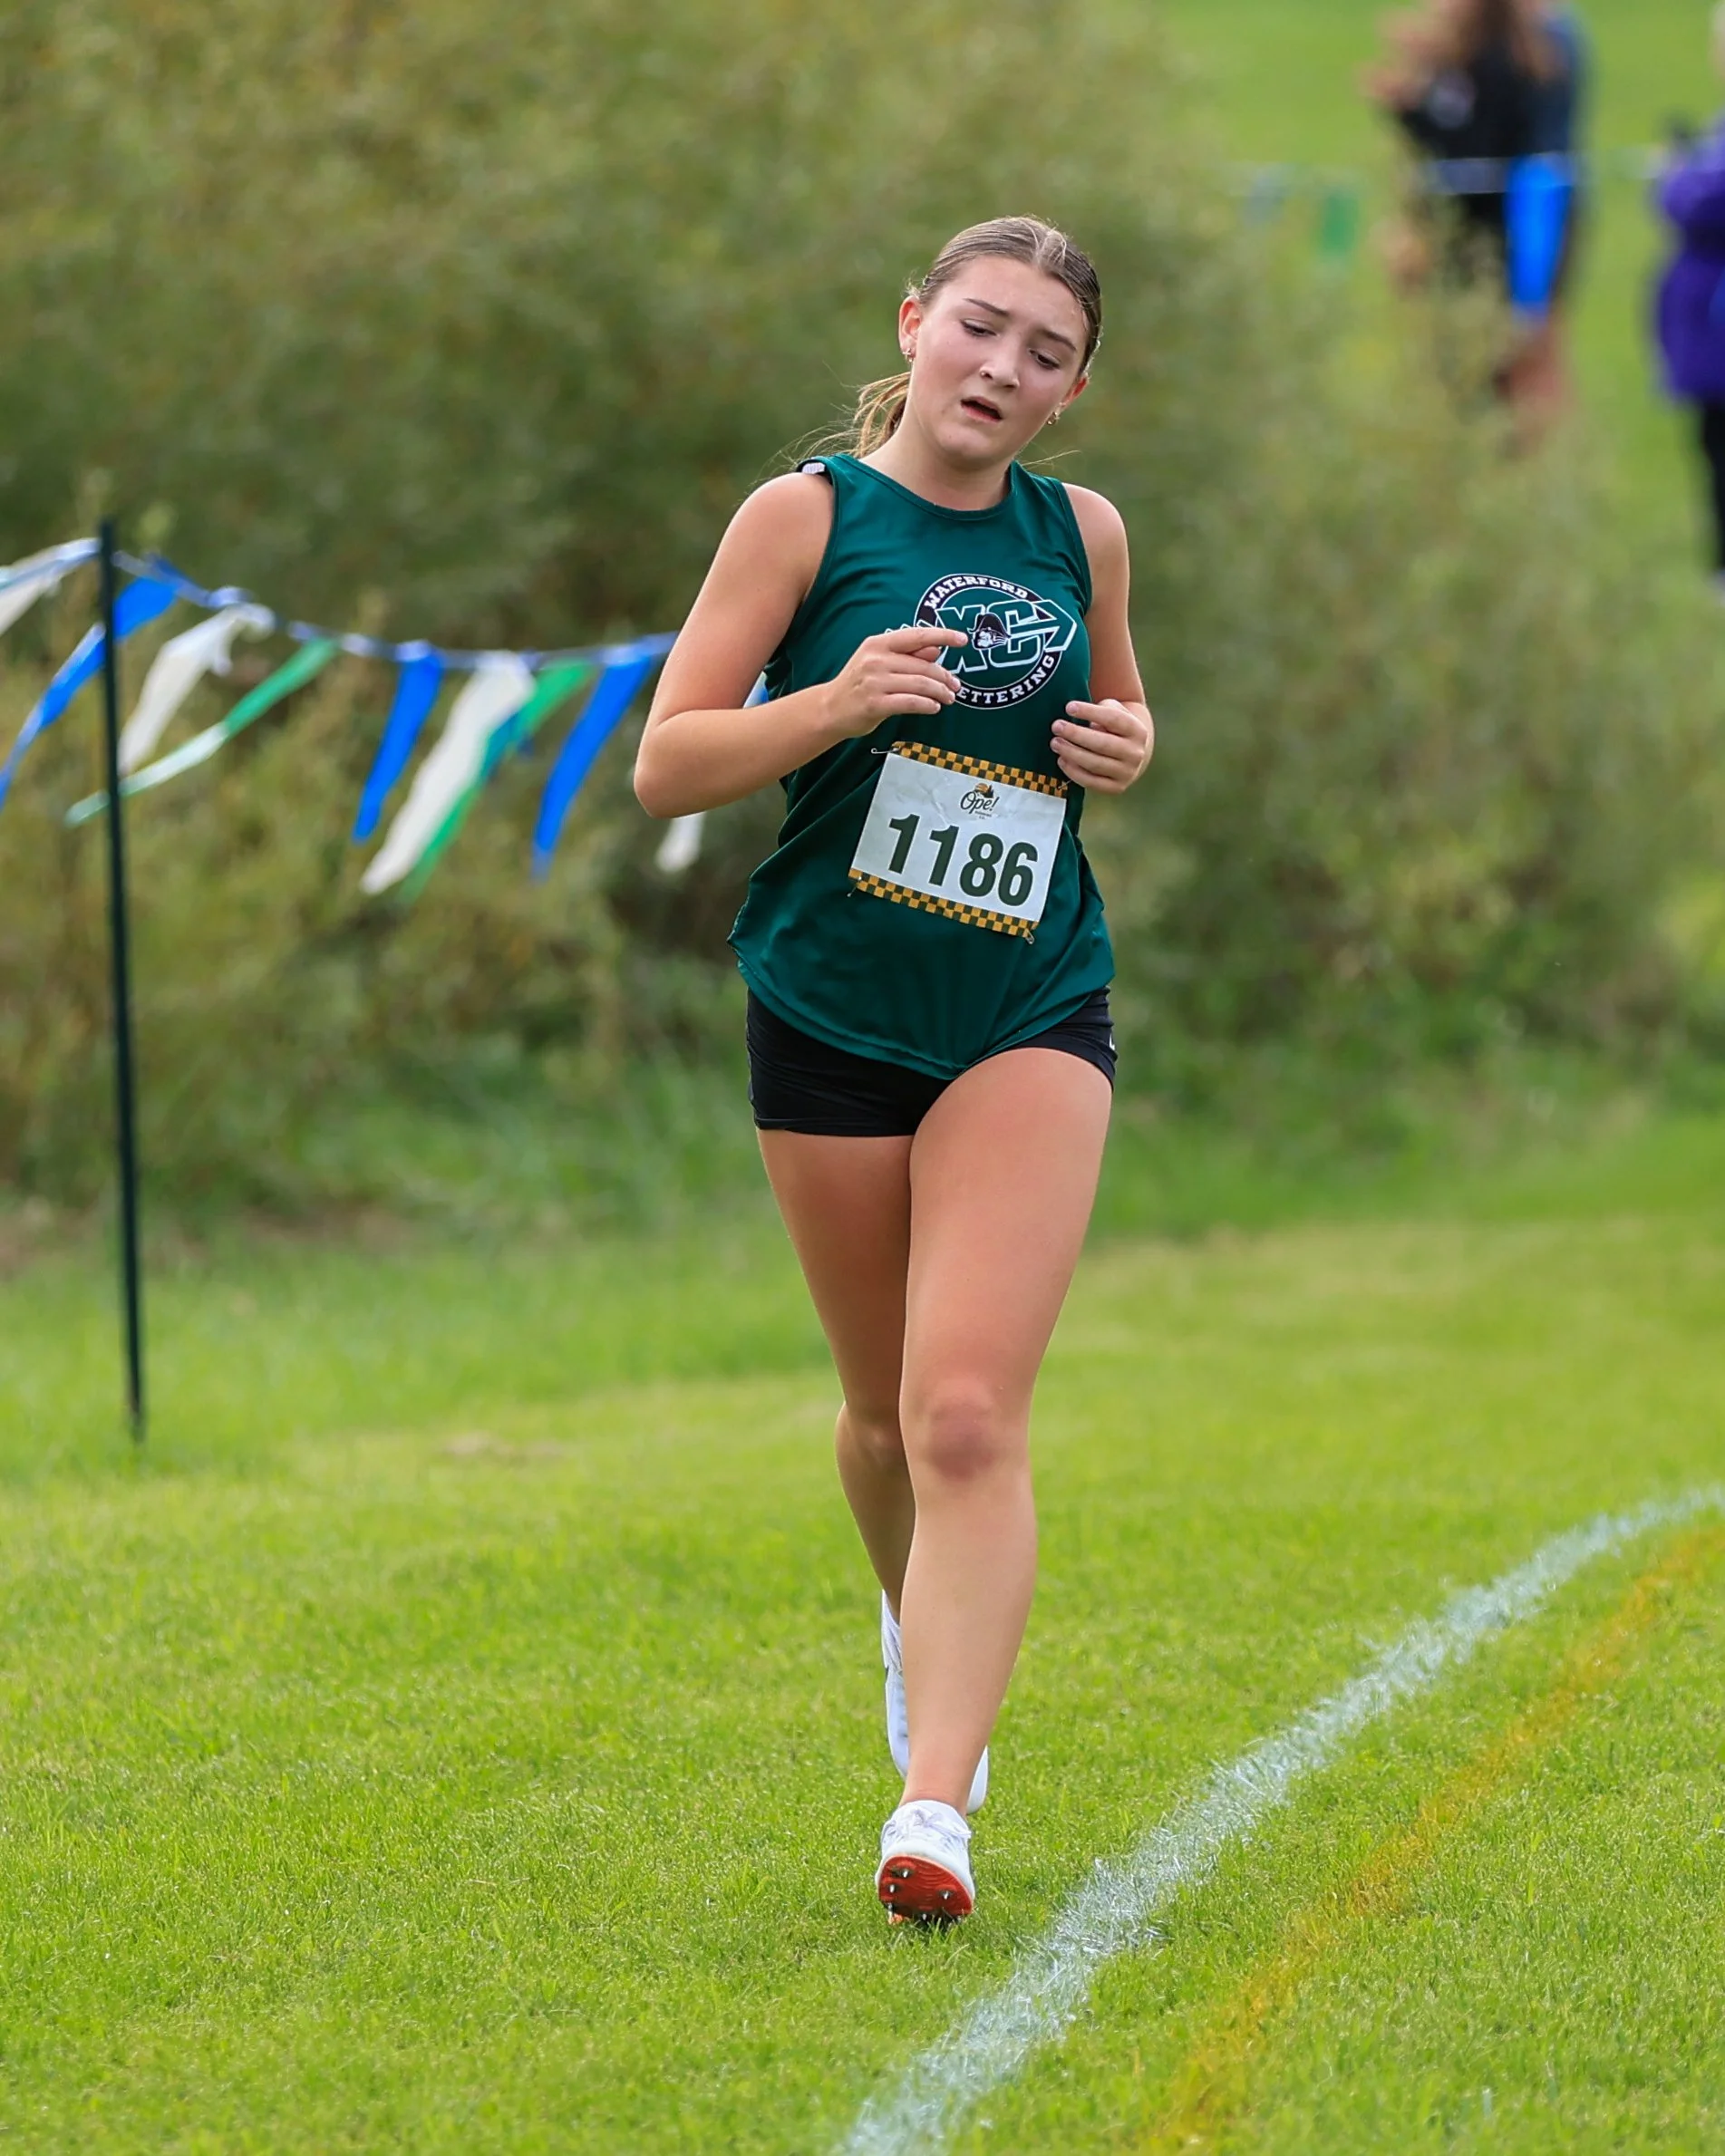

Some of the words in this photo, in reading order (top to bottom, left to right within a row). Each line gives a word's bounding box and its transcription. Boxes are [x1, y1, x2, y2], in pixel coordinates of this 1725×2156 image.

[924, 575, 1030, 610] WATERFORD
[955, 653, 1055, 704] ETTERING
[960, 790, 1001, 815] Ope!
[888, 813, 1039, 907] 1186
